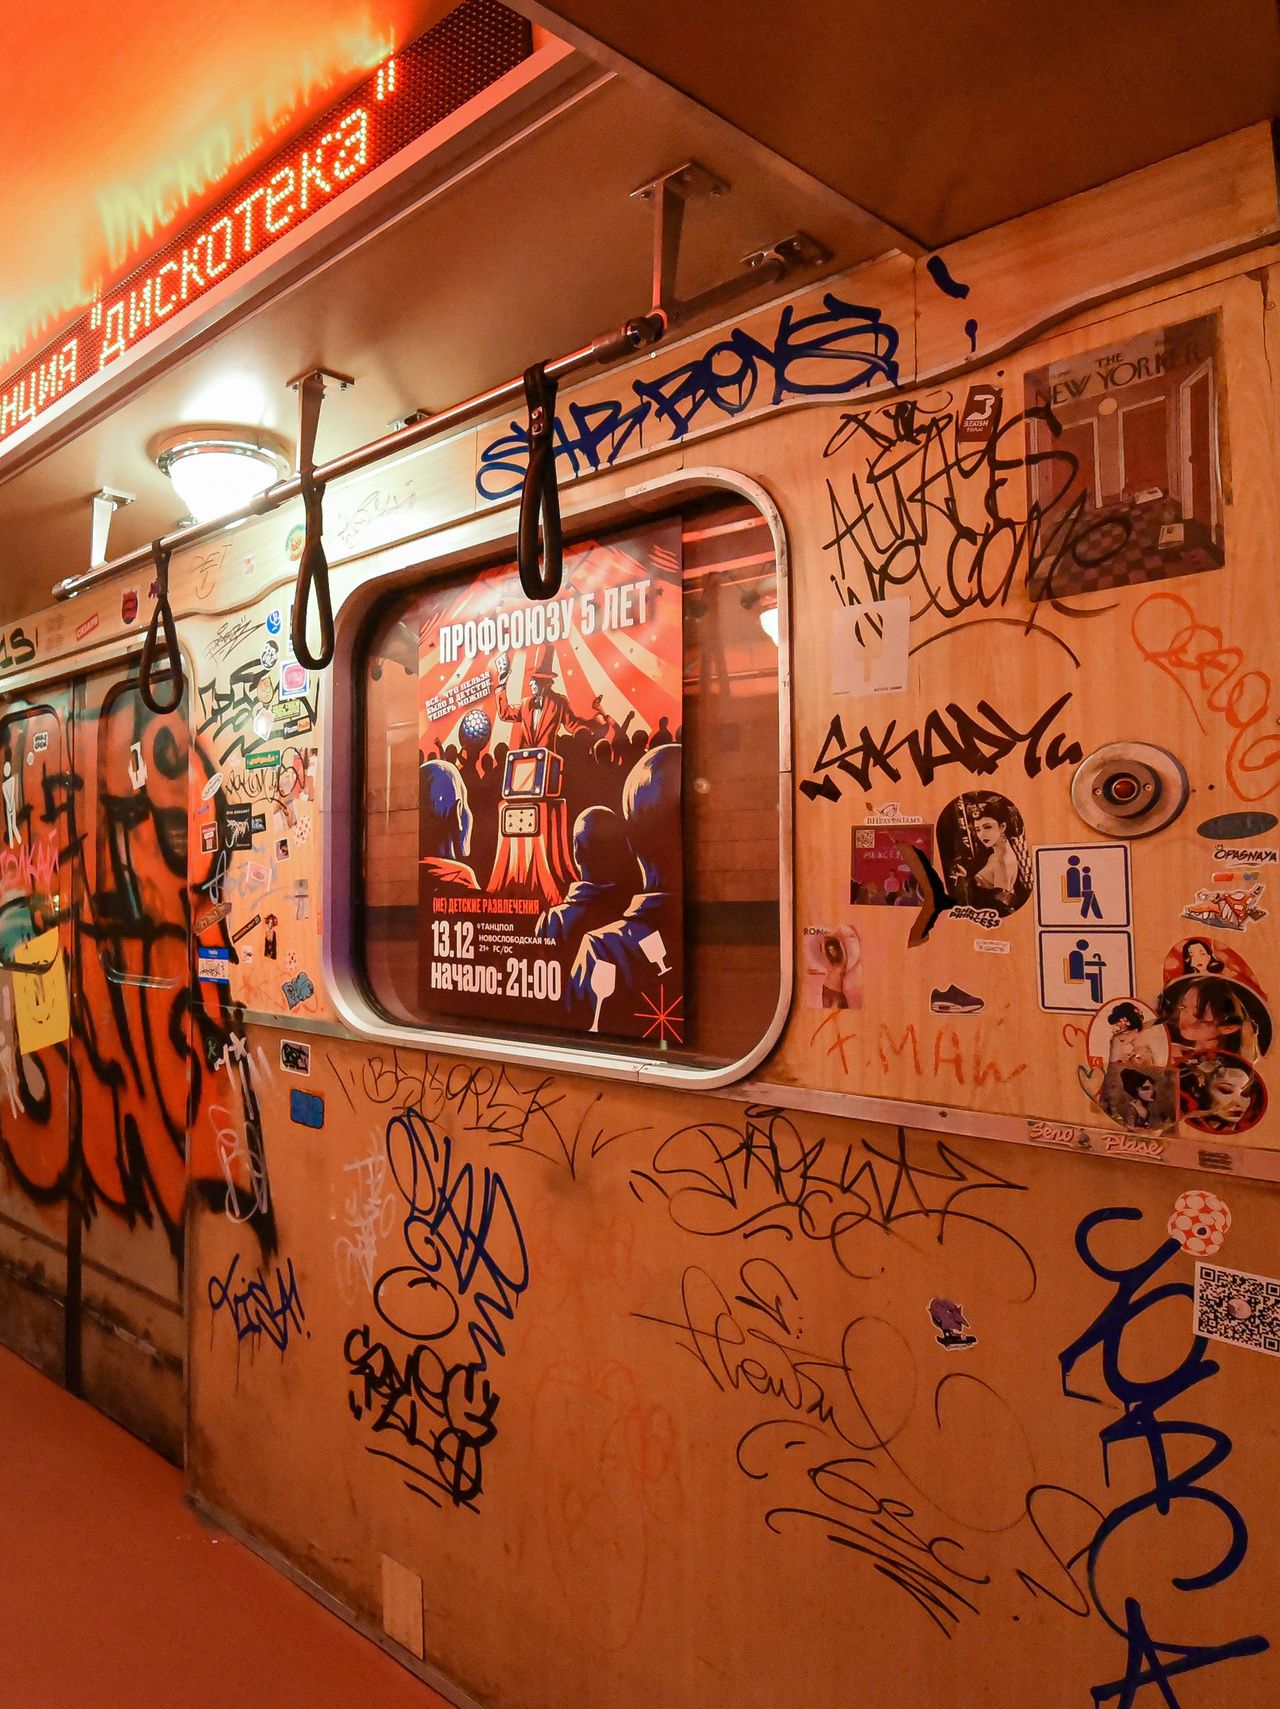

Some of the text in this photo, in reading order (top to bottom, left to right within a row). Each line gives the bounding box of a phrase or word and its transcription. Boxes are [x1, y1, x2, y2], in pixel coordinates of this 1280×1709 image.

[1095, 352, 1123, 368] THE
[1035, 374, 1091, 406] NEW
[439, 579, 651, 664] ПРОФСОЮЗУ 5 ЛЕТ
[443, 686, 459, 698] ЧТО
[460, 671, 490, 690] НЕЛЬЗЯ
[426, 700, 447, 715] БЫЛО
[448, 696, 454, 705] В
[428, 686, 491, 722] ТЕПЕРЬ МОЖНО!
[448, 898, 481, 914] ДЕТСКИЕ
[482, 898, 539, 915] РАЗВЛЕЧЕНИЯ
[481, 923, 514, 932] ТАНЦПОЛ
[431, 920, 475, 959] 13.12
[478, 934, 542, 945] НОВОСЛОБОДСКАЯ
[479, 944, 490, 952] 21+
[431, 957, 562, 1001] начало: 21:00
